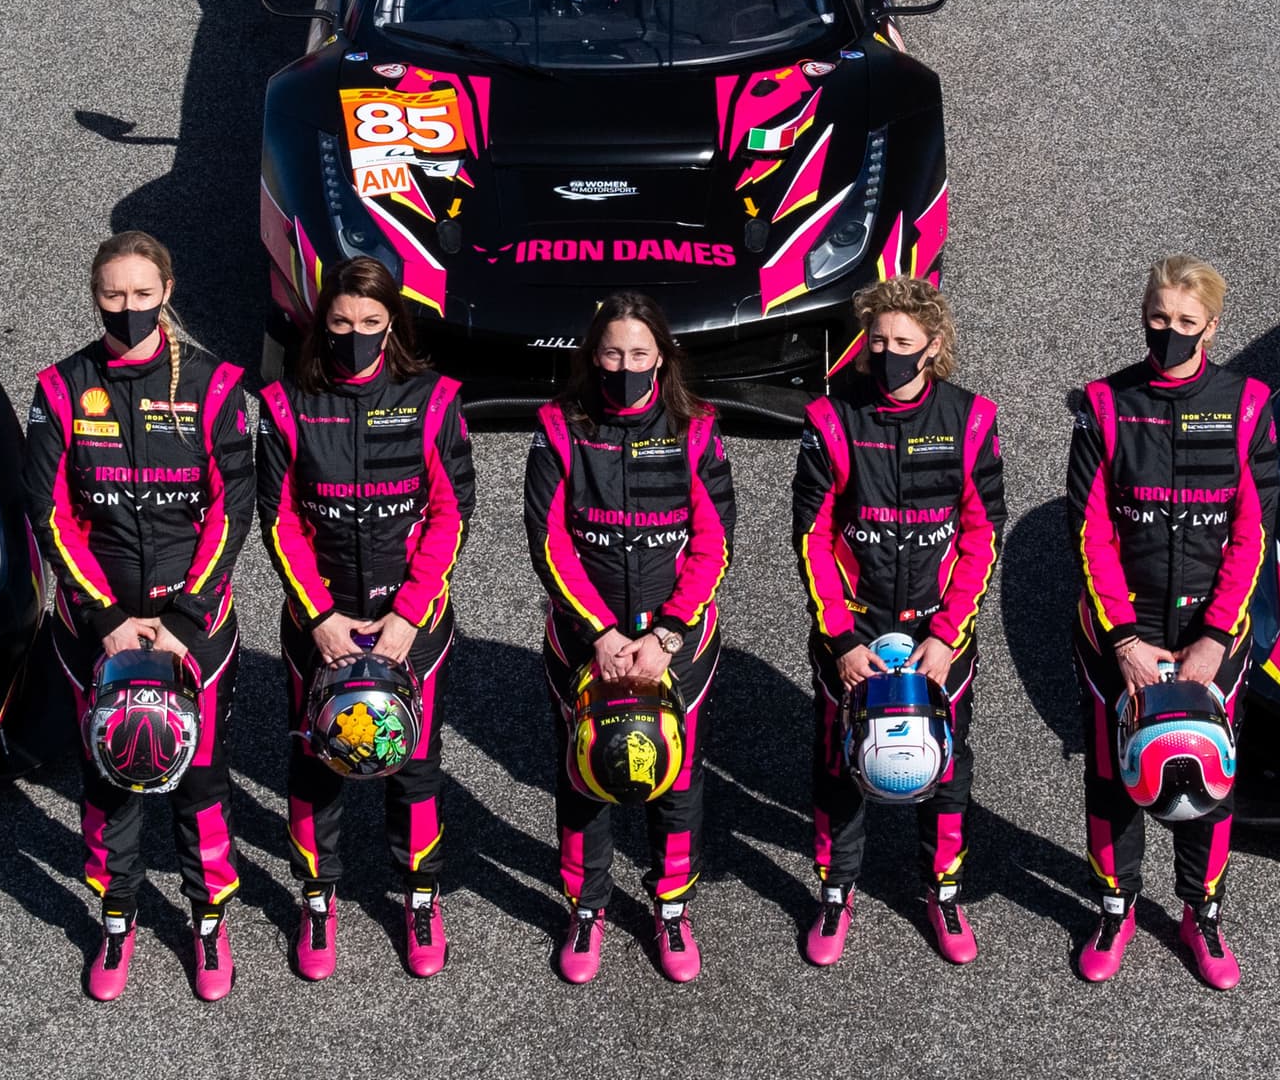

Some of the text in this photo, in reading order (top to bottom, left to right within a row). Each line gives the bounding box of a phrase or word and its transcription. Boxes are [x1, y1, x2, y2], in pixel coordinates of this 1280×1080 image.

[359, 91, 440, 104] DHL
[355, 102, 455, 149] 85
[362, 167, 406, 193] AM
[515, 239, 736, 267] IRON DAMES
[527, 337, 580, 349] niki
[96, 466, 201, 483] IRON DAMES
[317, 477, 419, 498] IRON DAMES
[1133, 487, 1238, 504] IRON DAMES
[156, 491, 200, 505] LYNX
[588, 507, 688, 526] IRON DAMES
[861, 505, 903, 522] IRON
[844, 521, 955, 547] IRON LYNX
